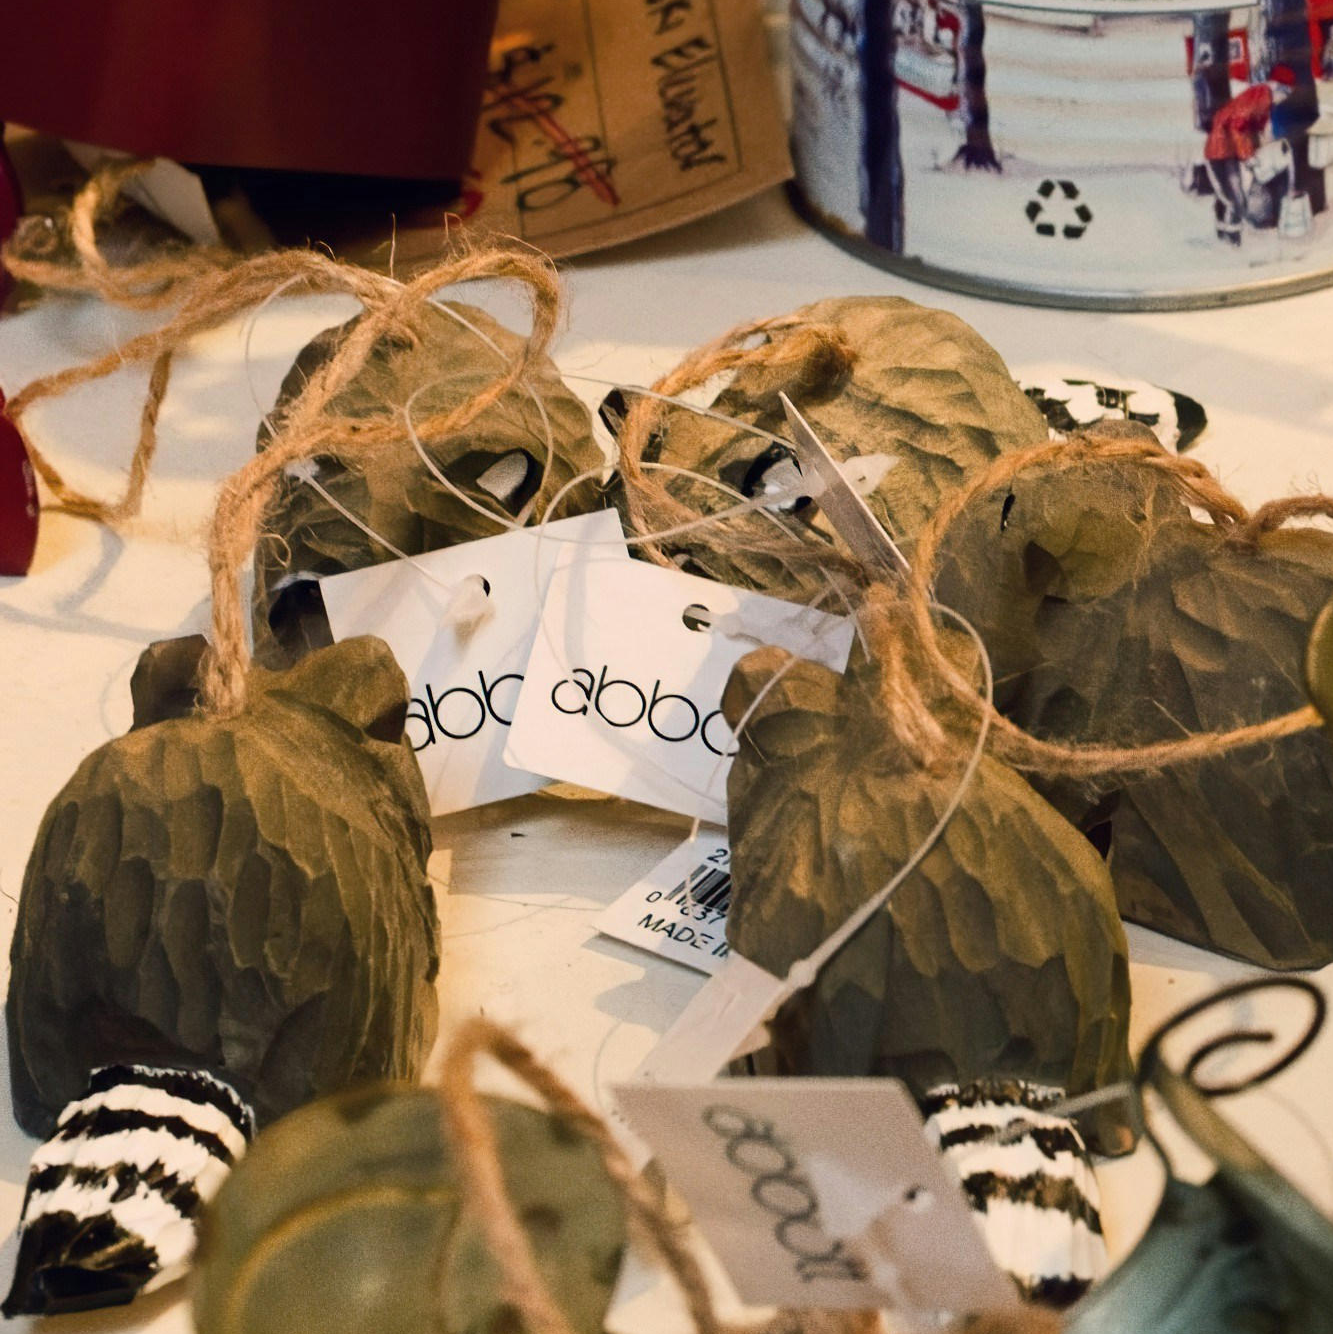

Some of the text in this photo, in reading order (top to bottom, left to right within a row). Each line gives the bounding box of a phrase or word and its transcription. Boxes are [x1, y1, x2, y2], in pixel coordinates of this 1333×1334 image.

[405, 670, 524, 752] abb
[551, 664, 740, 757] abbo
[637, 913, 715, 950] MADE
